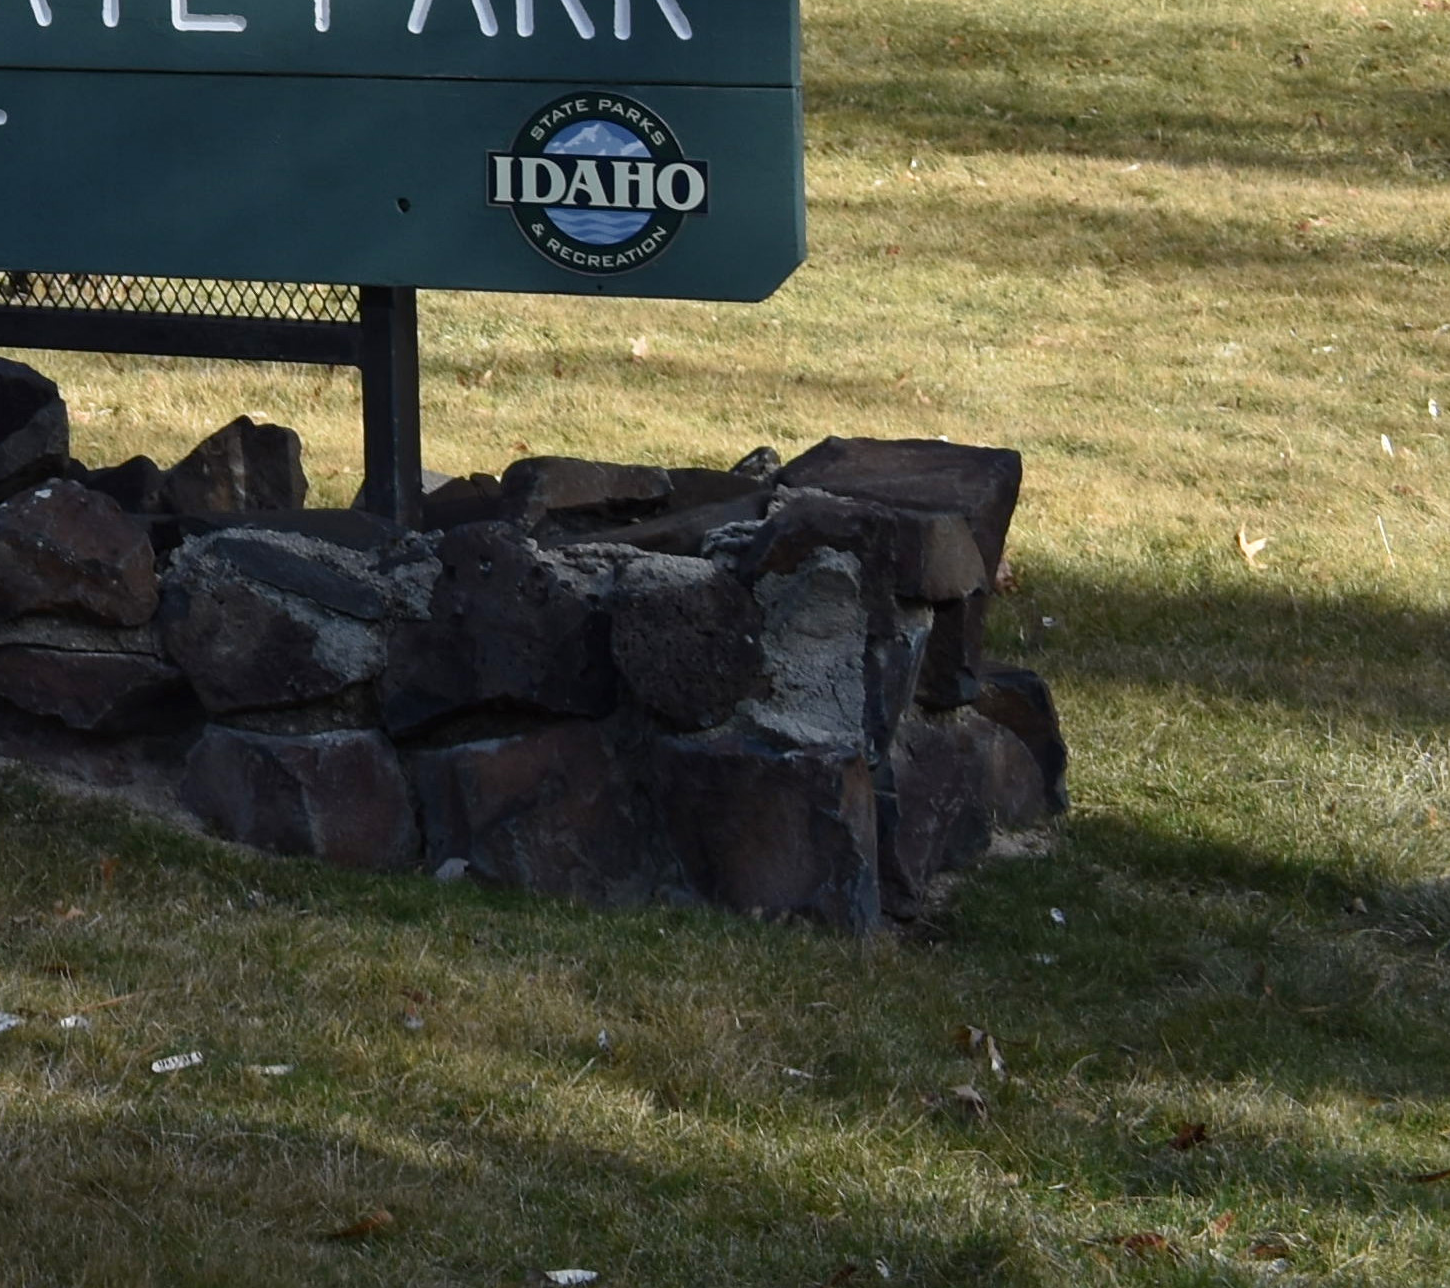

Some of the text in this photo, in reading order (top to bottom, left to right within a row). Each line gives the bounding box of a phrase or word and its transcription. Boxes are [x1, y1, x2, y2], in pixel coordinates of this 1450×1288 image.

[530, 98, 666, 147] STATE PARKS
[493, 156, 706, 212] IDAHO
[530, 222, 668, 268] & RECREATION
